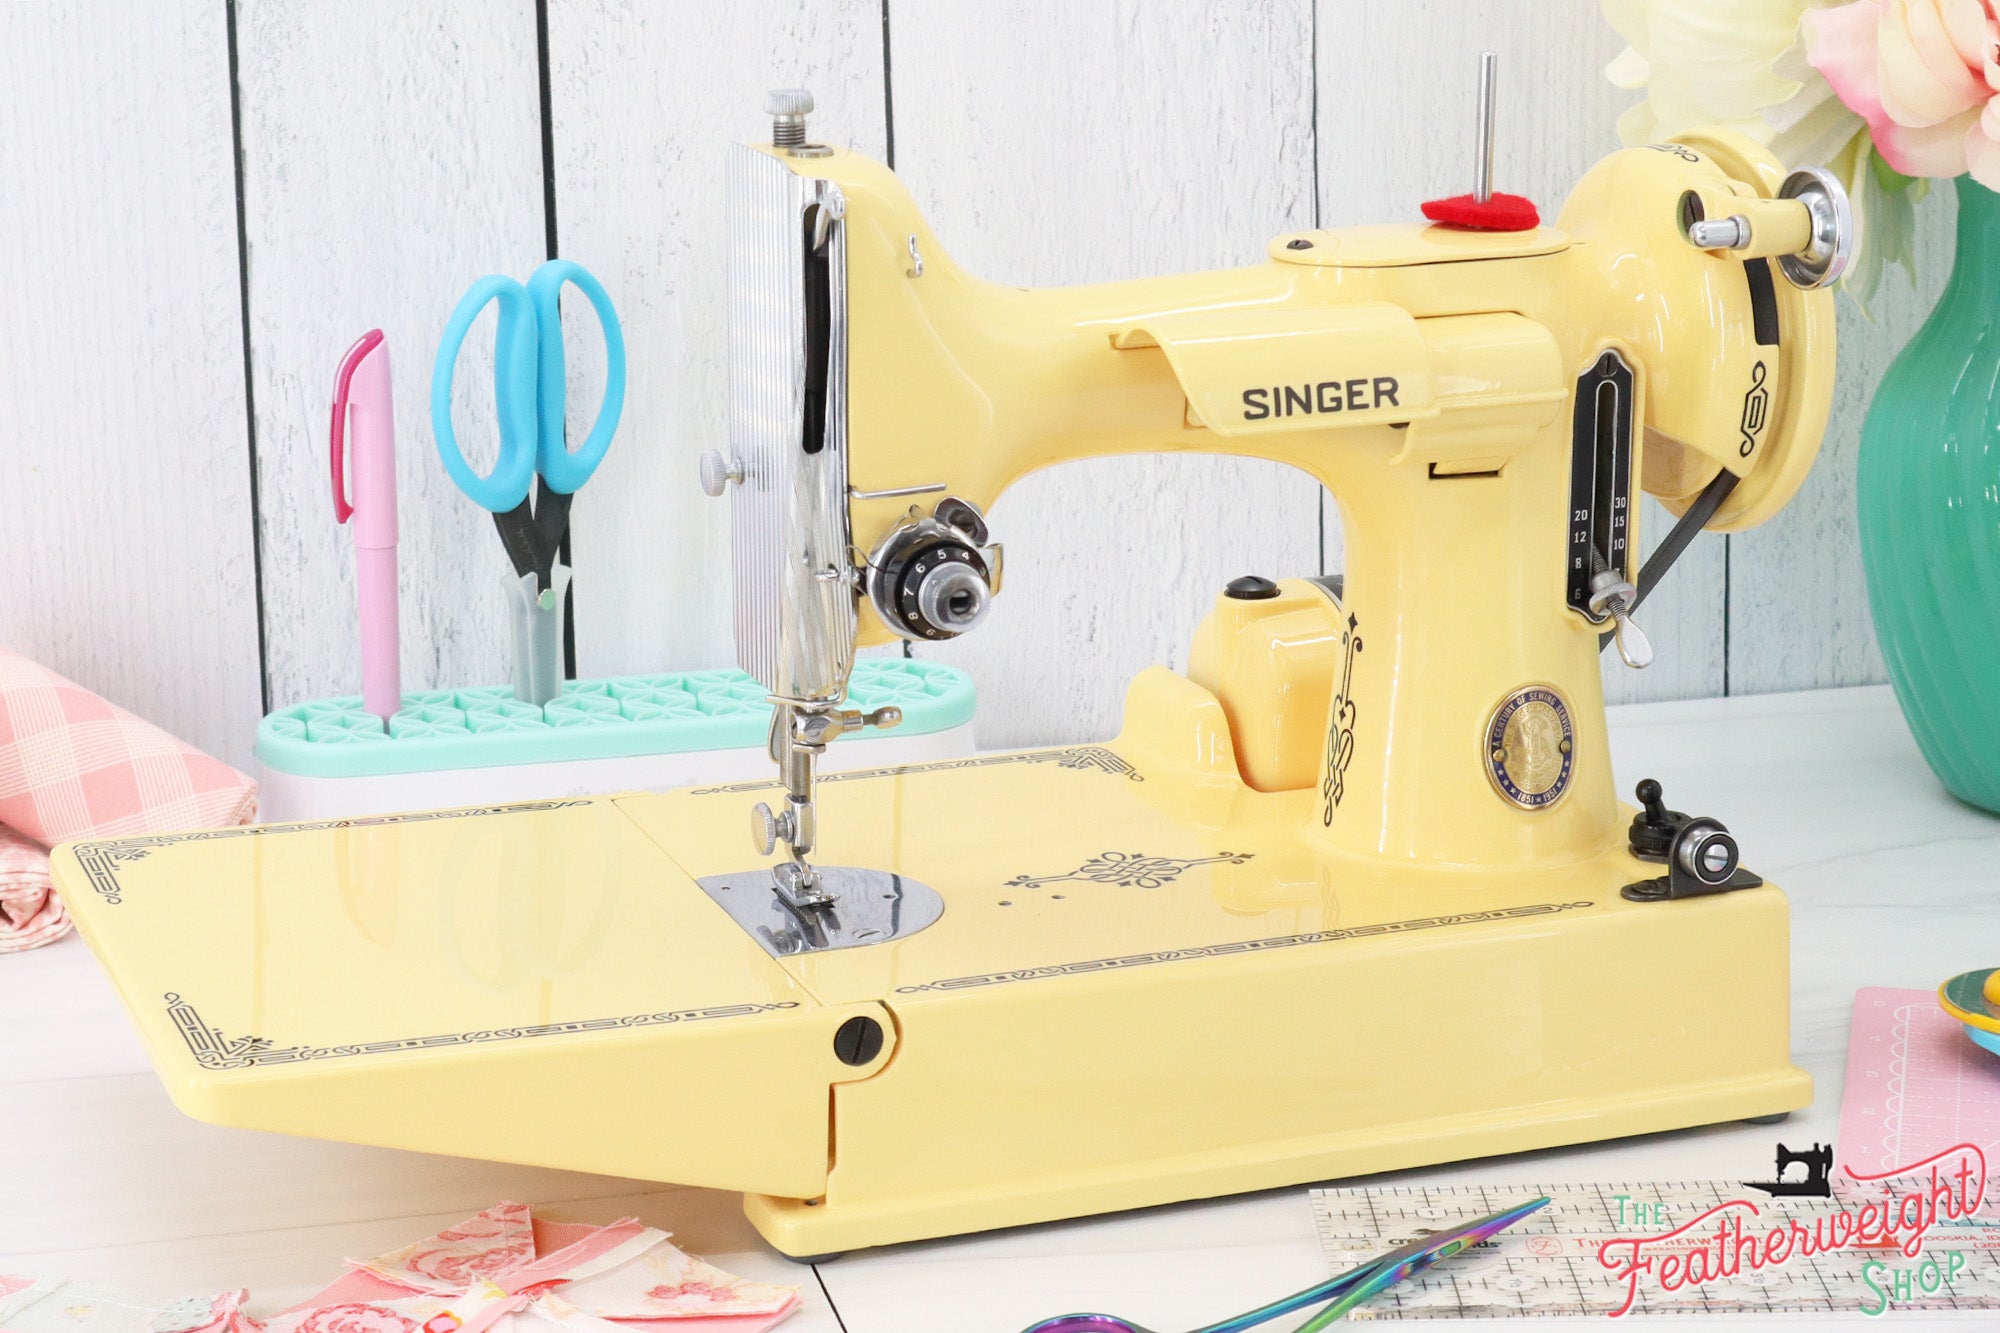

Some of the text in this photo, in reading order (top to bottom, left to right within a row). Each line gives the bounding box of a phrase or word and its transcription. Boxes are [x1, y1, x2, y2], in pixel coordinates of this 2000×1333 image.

[1243, 377, 1399, 420] SINGER
[1615, 497, 1627, 508] 30
[1574, 510, 1588, 521] 20
[1614, 516, 1625, 527] 15
[1574, 531, 1587, 543] 12
[1613, 538, 1625, 550] 10
[937, 549, 947, 560] 5
[961, 551, 970, 560] 4
[915, 563, 926, 573] 6
[1575, 558, 1582, 569] 8
[904, 587, 915, 597] 7
[1574, 588, 1582, 600] 6
[908, 612, 919, 621] 8
[1494, 704, 1516, 738] CENTURY
[1516, 695, 1526, 705] OF
[1529, 691, 1557, 706] SEWING
[1556, 704, 1570, 737] SERVICE
[1517, 787, 1558, 803] 1851 1951
